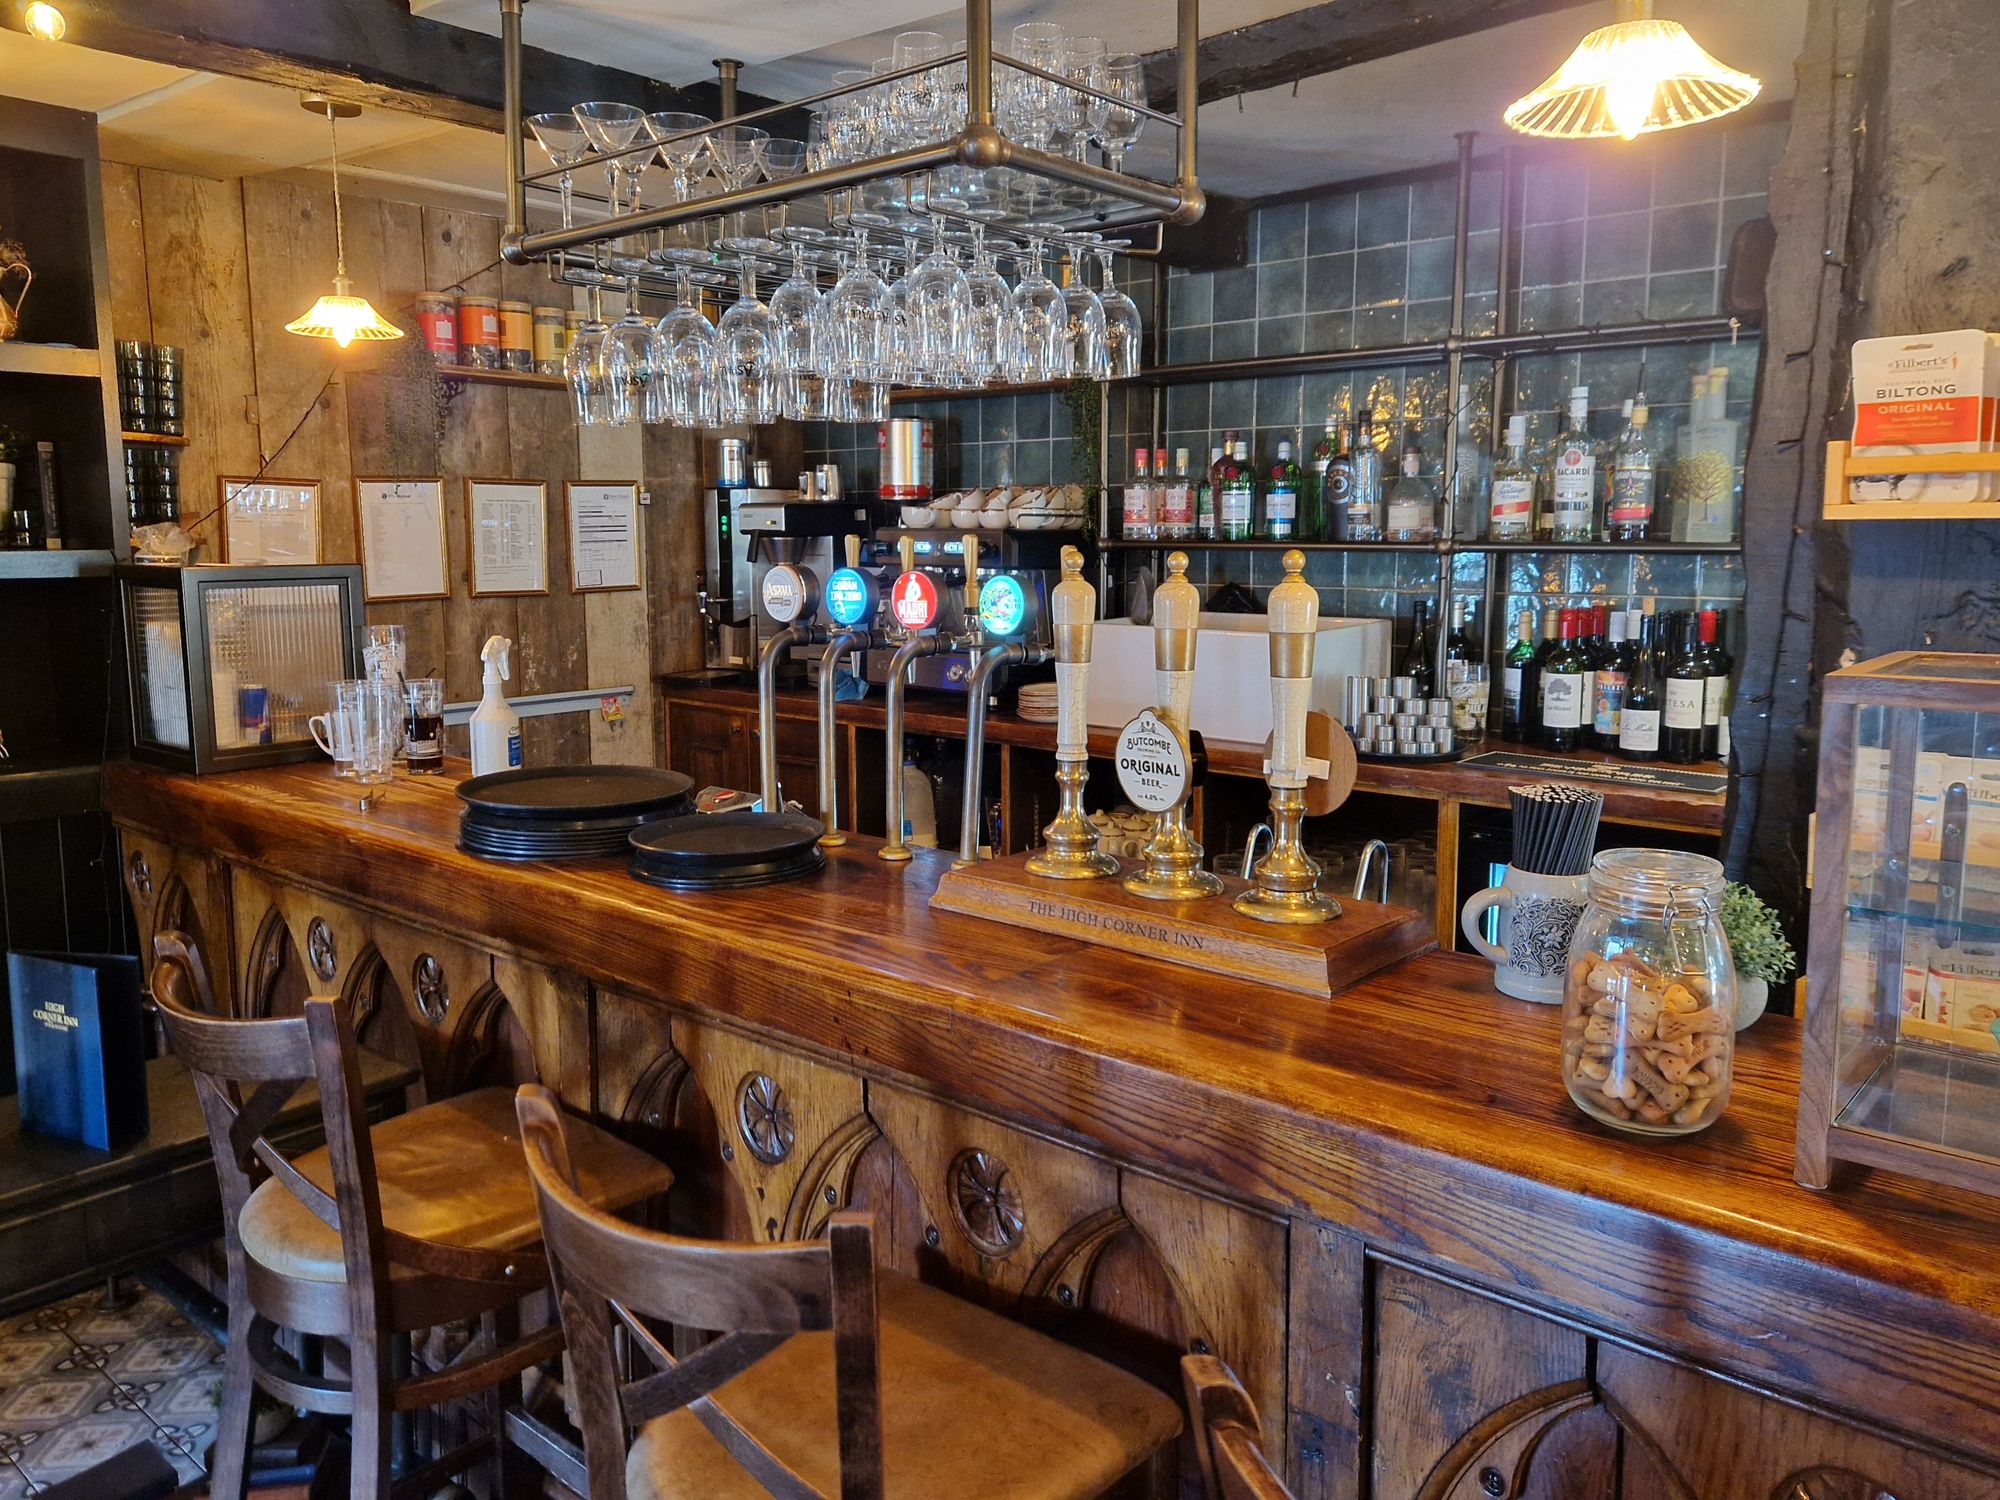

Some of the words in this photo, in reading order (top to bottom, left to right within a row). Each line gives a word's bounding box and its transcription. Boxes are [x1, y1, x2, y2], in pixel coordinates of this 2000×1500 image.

[1876, 384, 1957, 399] BILTONG
[1877, 402, 1956, 415] ORIGINAL
[1126, 737, 1172, 755] BUTCOMBE
[1120, 758, 1181, 777] ORIGINAL
[1141, 778, 1163, 789] BEER
[1028, 900, 1056, 917] THE
[1060, 907, 1099, 927] HIGH
[1103, 916, 1169, 943] CORNER
[1174, 931, 1204, 949] INN
[44, 1001, 65, 1014] HIGH
